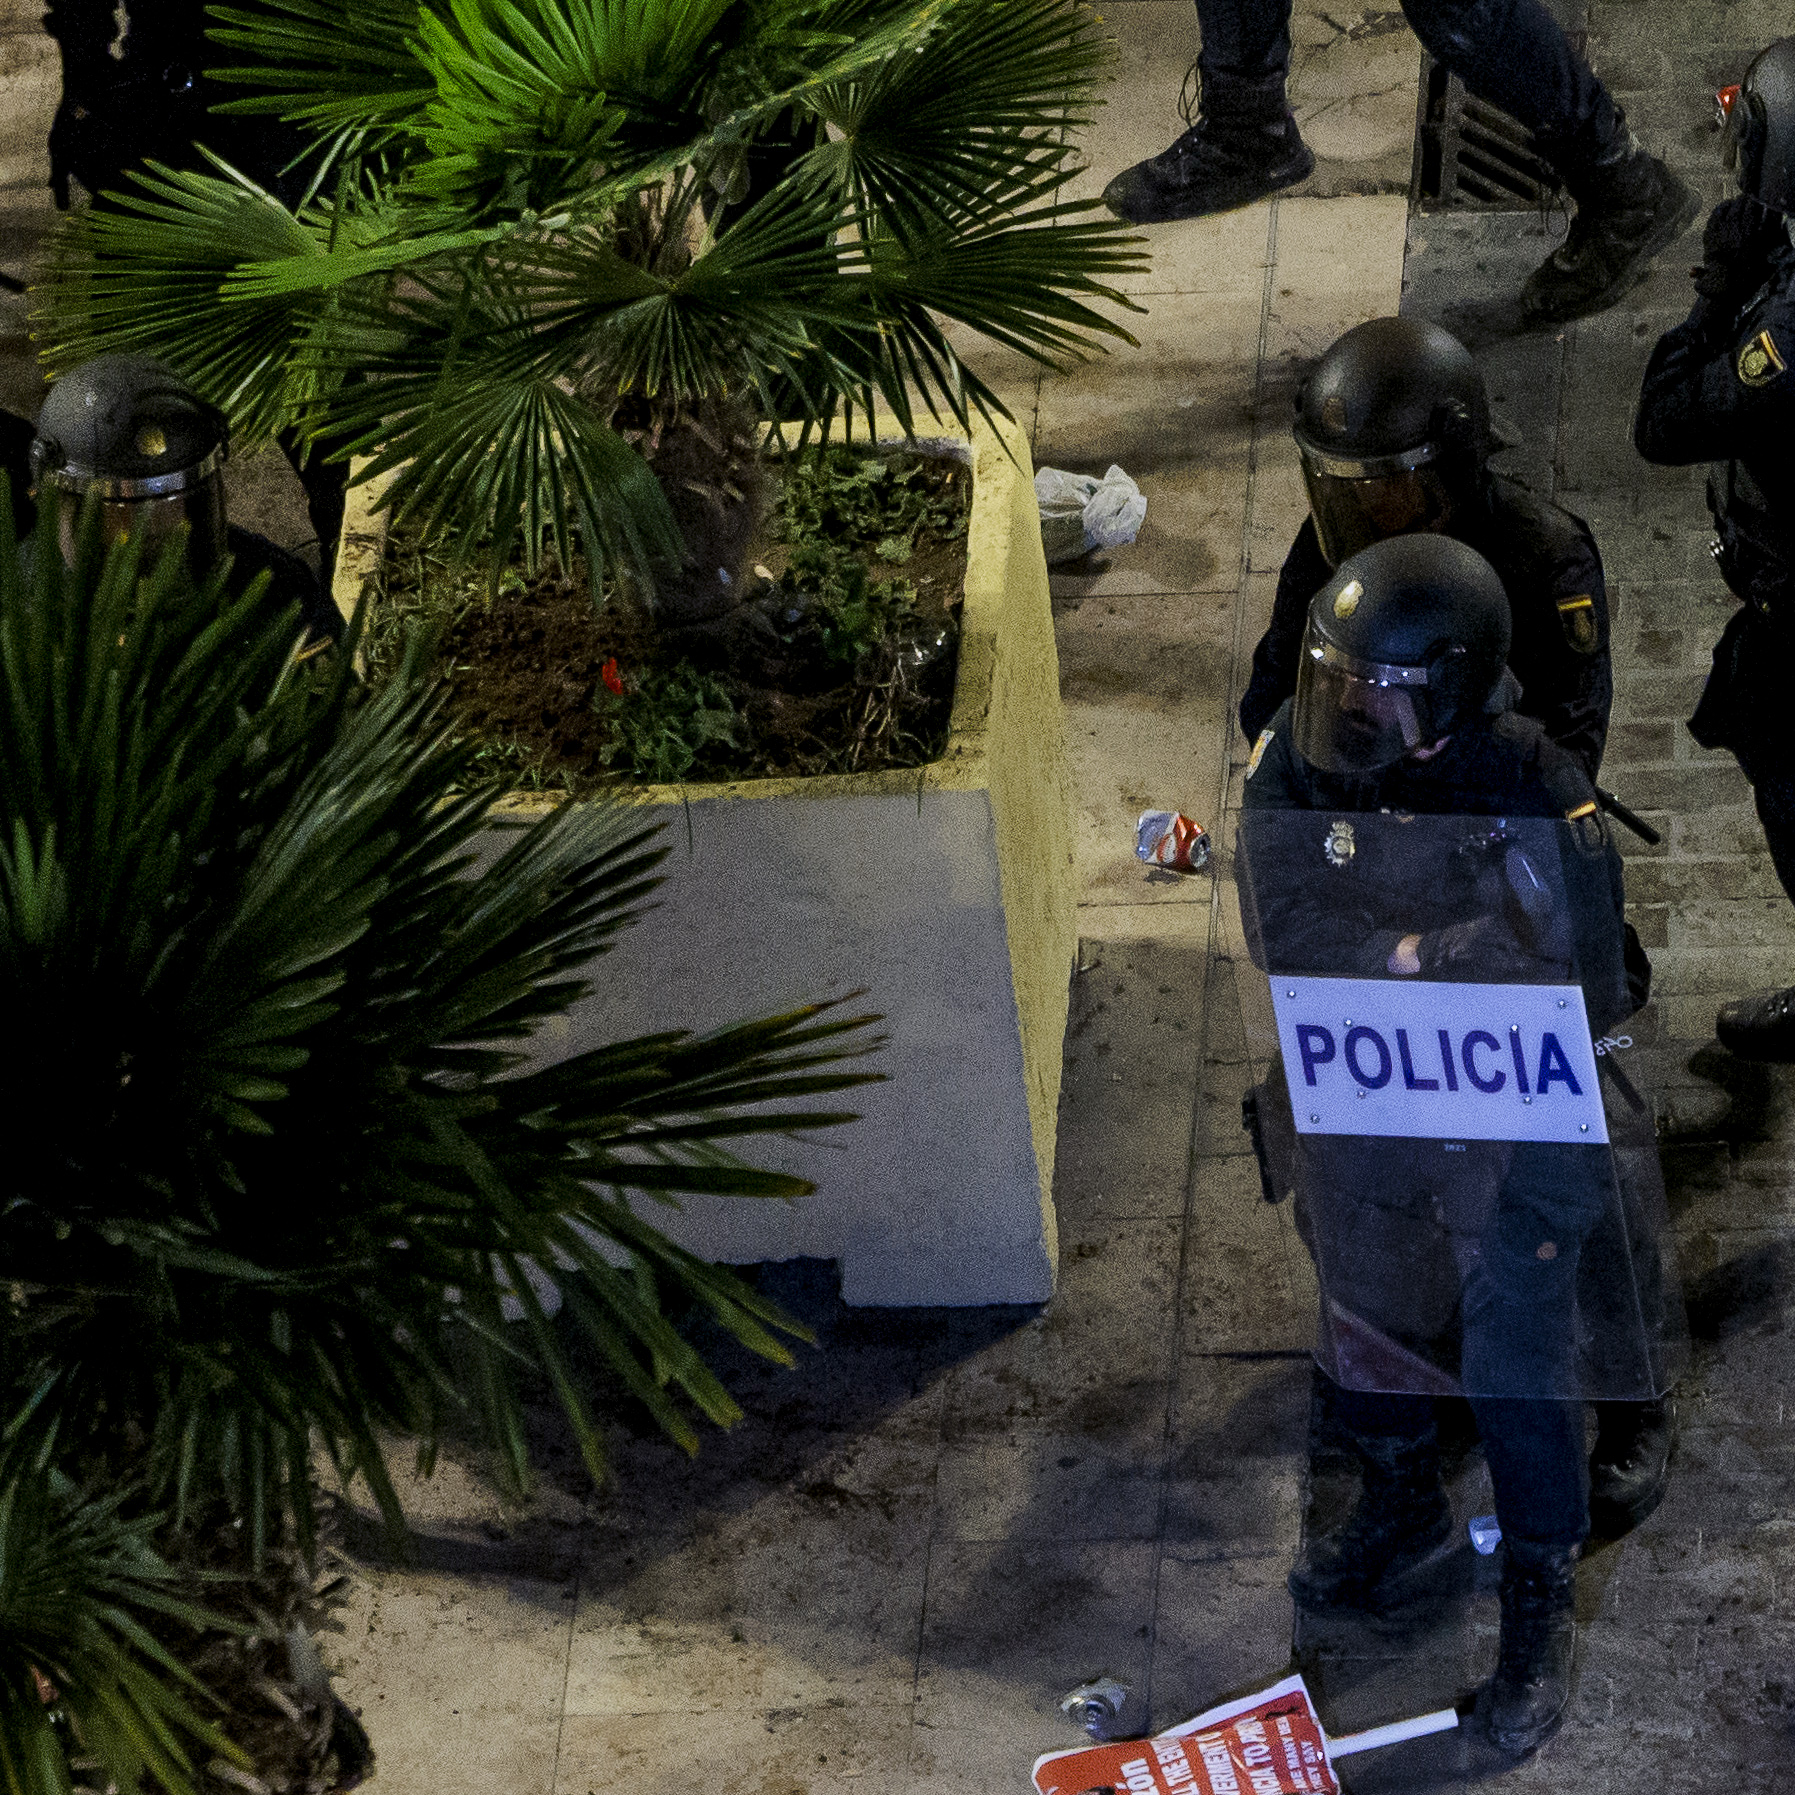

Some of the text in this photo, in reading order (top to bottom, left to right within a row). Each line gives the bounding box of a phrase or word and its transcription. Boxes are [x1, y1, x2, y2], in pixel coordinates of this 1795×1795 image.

[1295, 1021, 1584, 1097] POLICIA
[1242, 1743, 1273, 1767] TO
[1160, 1757, 1195, 1787] THE
